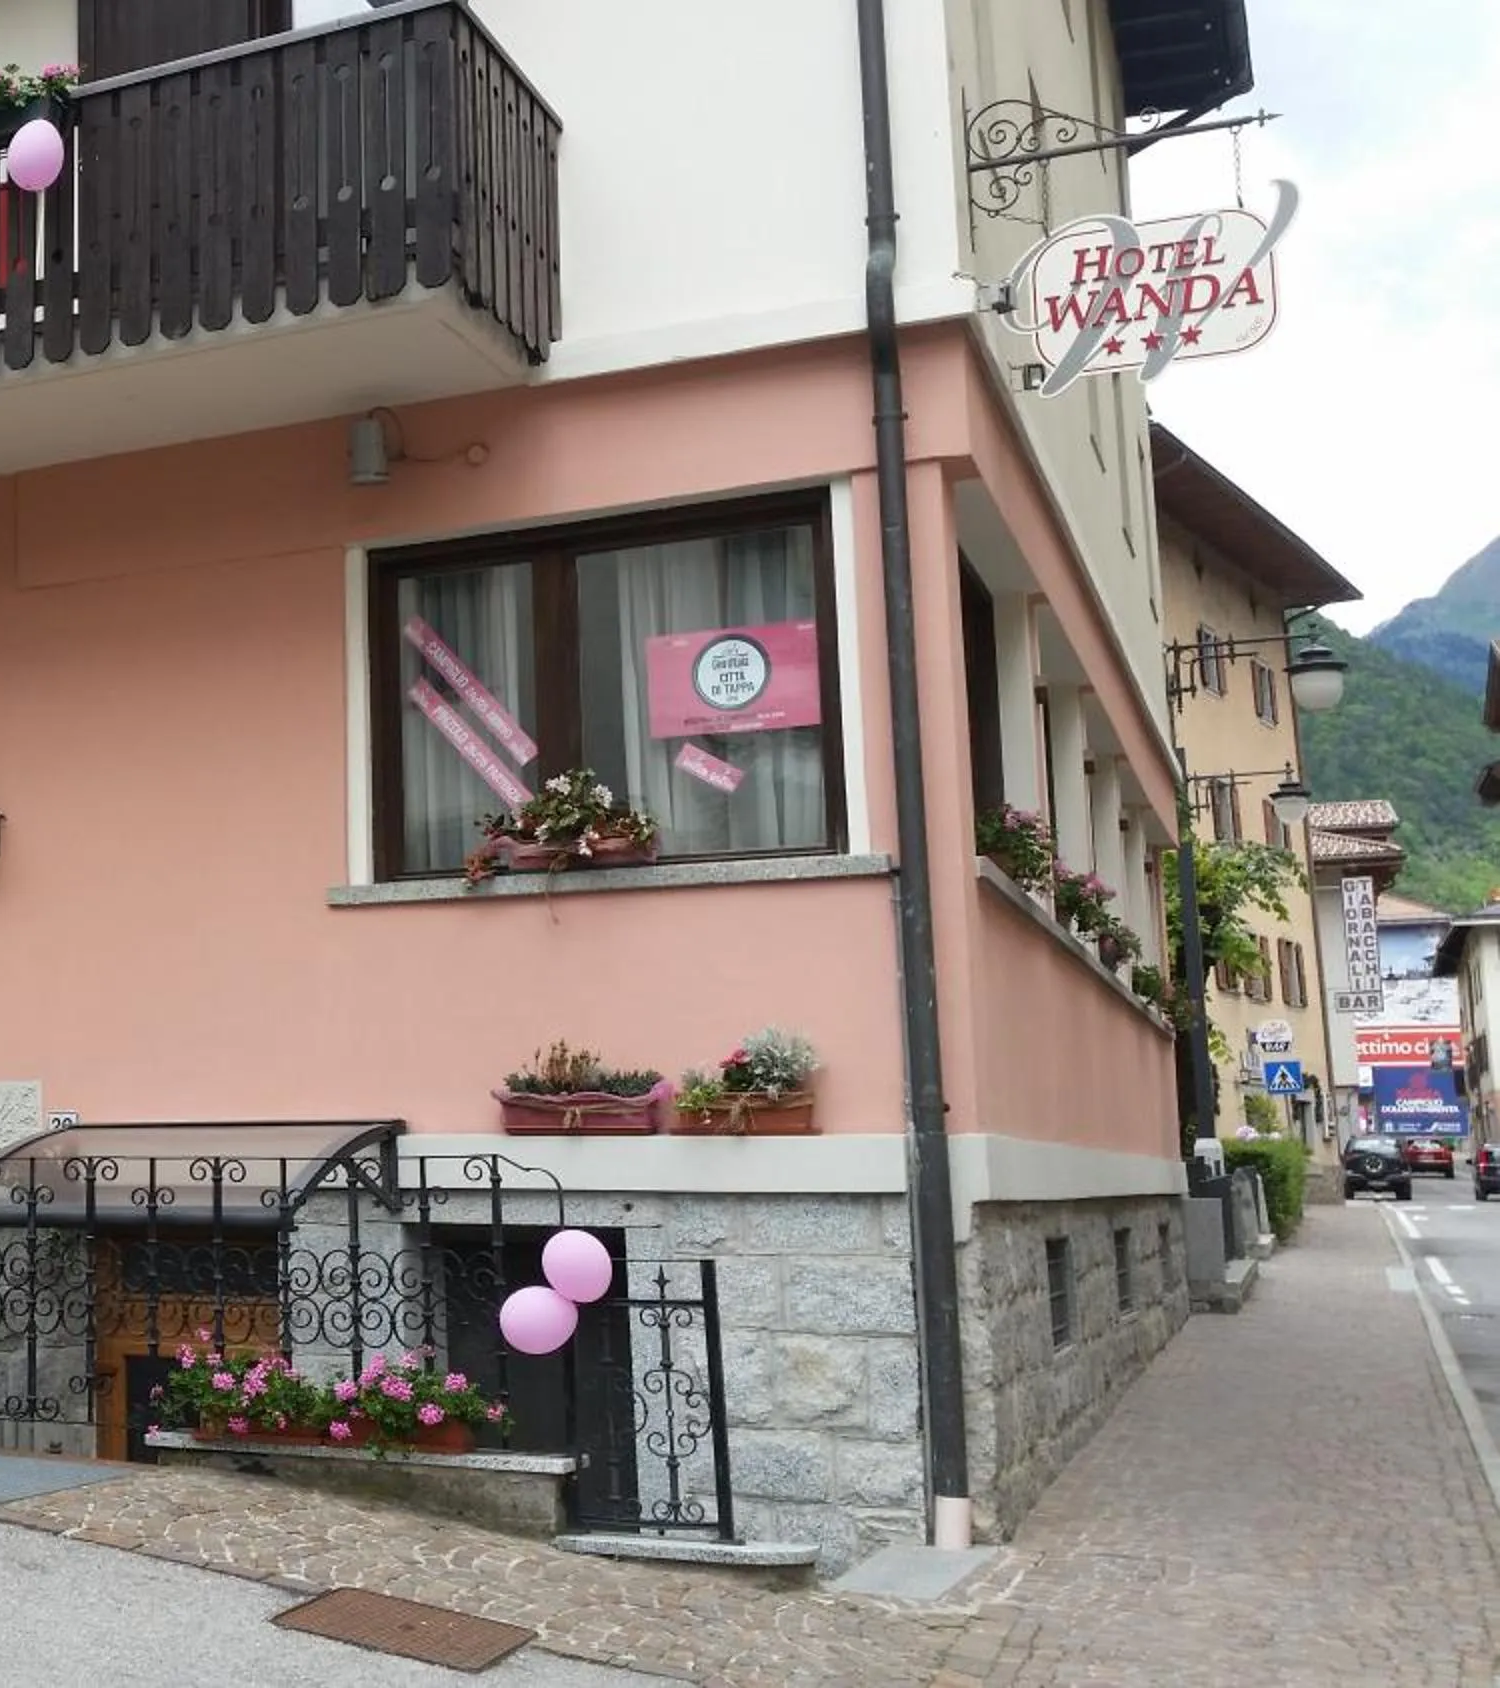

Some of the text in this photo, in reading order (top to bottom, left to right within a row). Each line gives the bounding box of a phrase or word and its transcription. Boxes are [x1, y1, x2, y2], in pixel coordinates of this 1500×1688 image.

[1069, 235, 1226, 286] HOTEL
[1043, 266, 1266, 333] WANDA
[1343, 880, 1362, 989] GIORNALI
[1360, 879, 1377, 989] TABACCHI
[1338, 995, 1379, 1009] BAR
